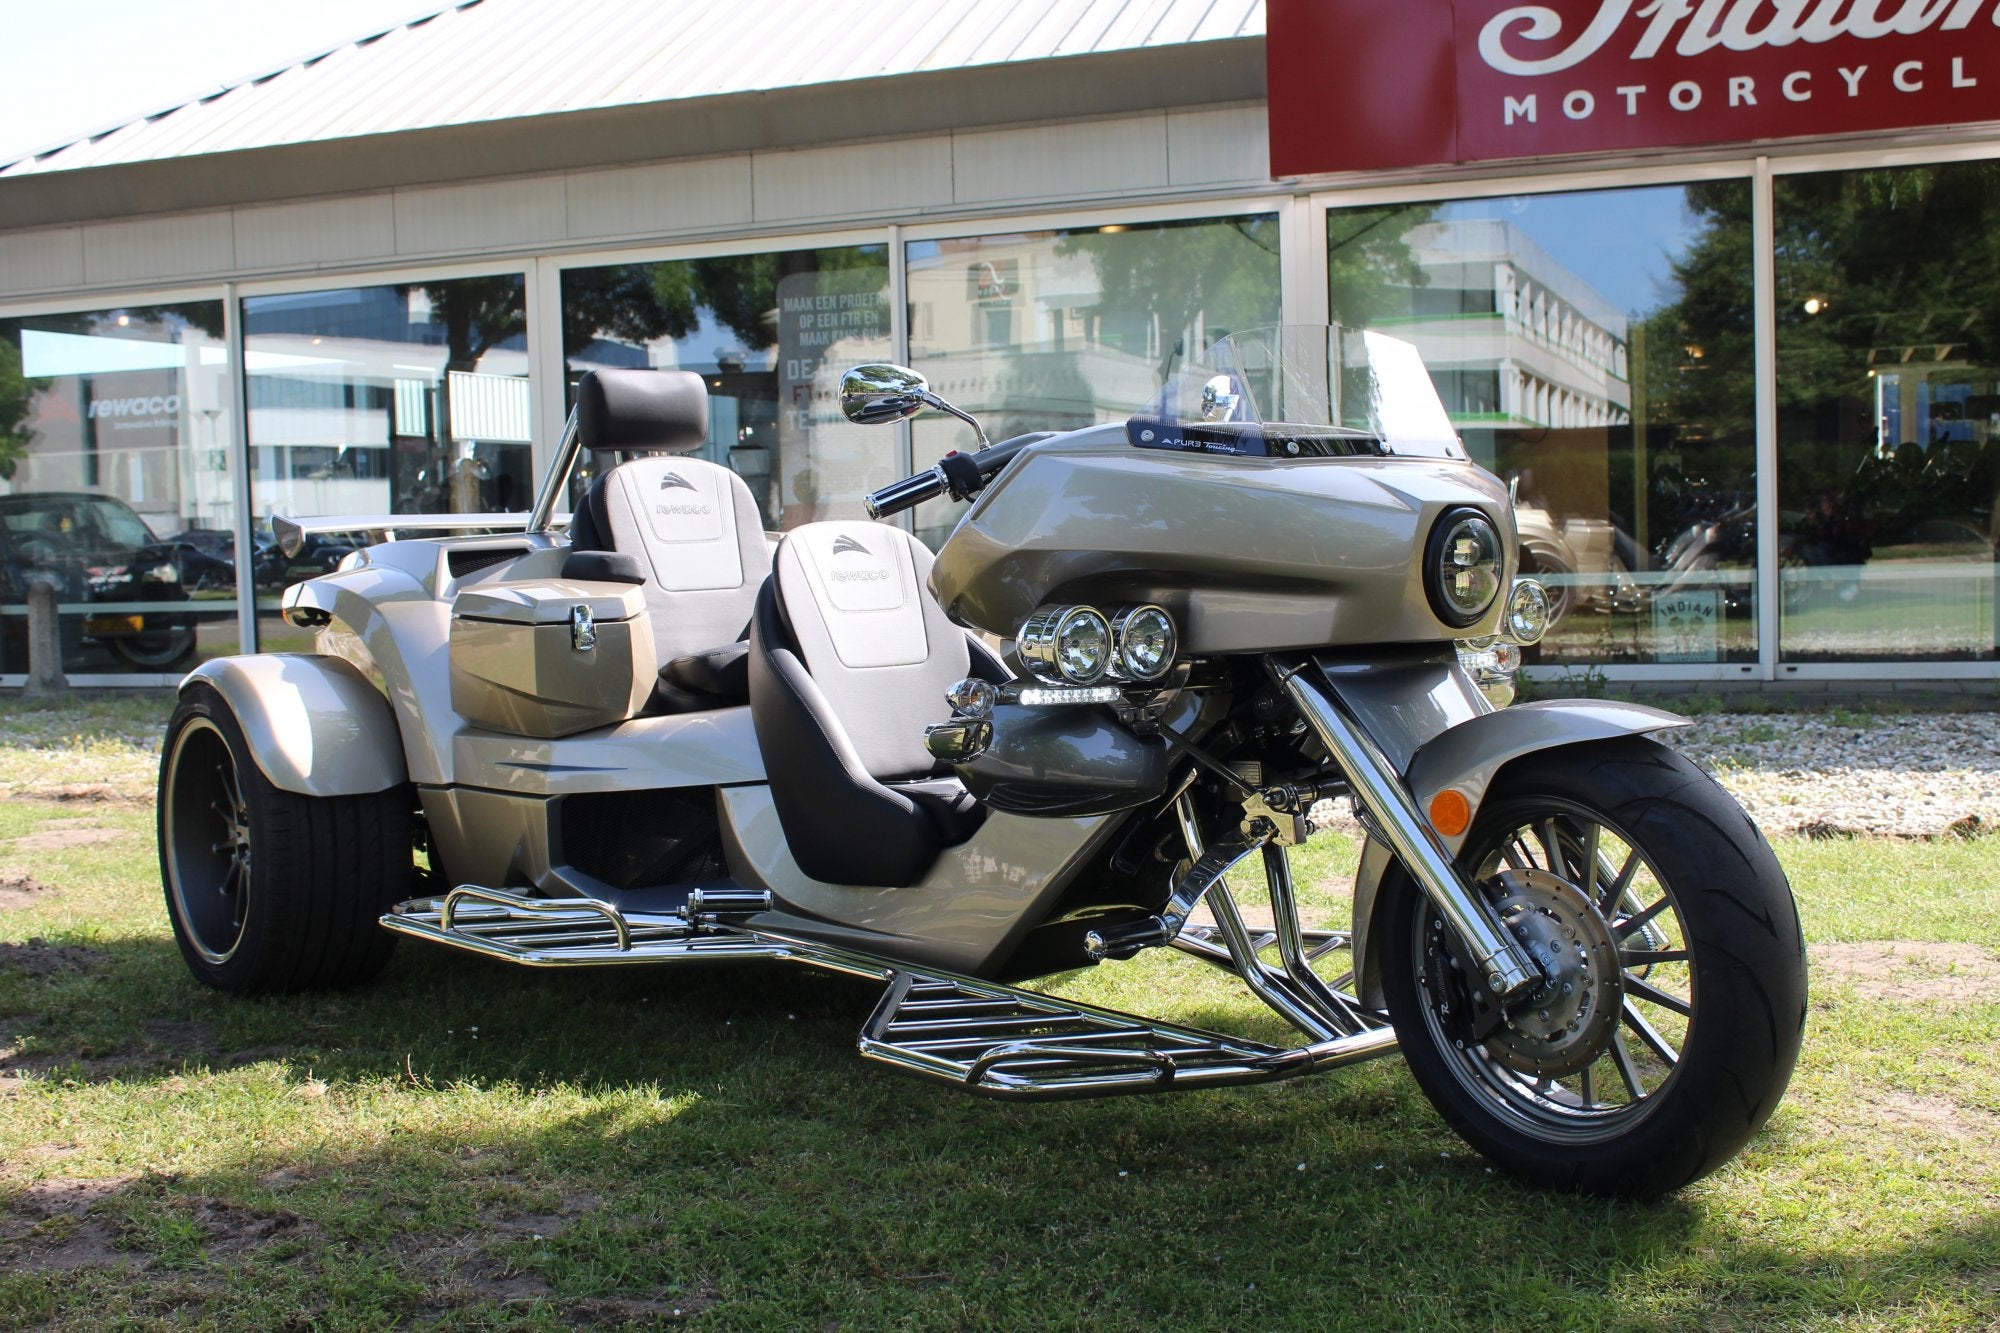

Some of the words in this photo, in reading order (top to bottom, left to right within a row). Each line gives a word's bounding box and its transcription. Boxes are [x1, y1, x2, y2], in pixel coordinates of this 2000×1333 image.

[784, 297, 814, 312] MAAK
[816, 295, 837, 310] EEN
[799, 314, 815, 329] OP
[817, 313, 839, 328] EEN
[841, 312, 862, 326] FTR
[864, 311, 879, 324] EN
[799, 331, 829, 346] MAAK
[787, 358, 814, 381] DE
[88, 394, 182, 418] rewaco
[656, 503, 712, 515] rewaco
[830, 568, 891, 581] rewaco
[1660, 601, 1714, 617] INDIAN
